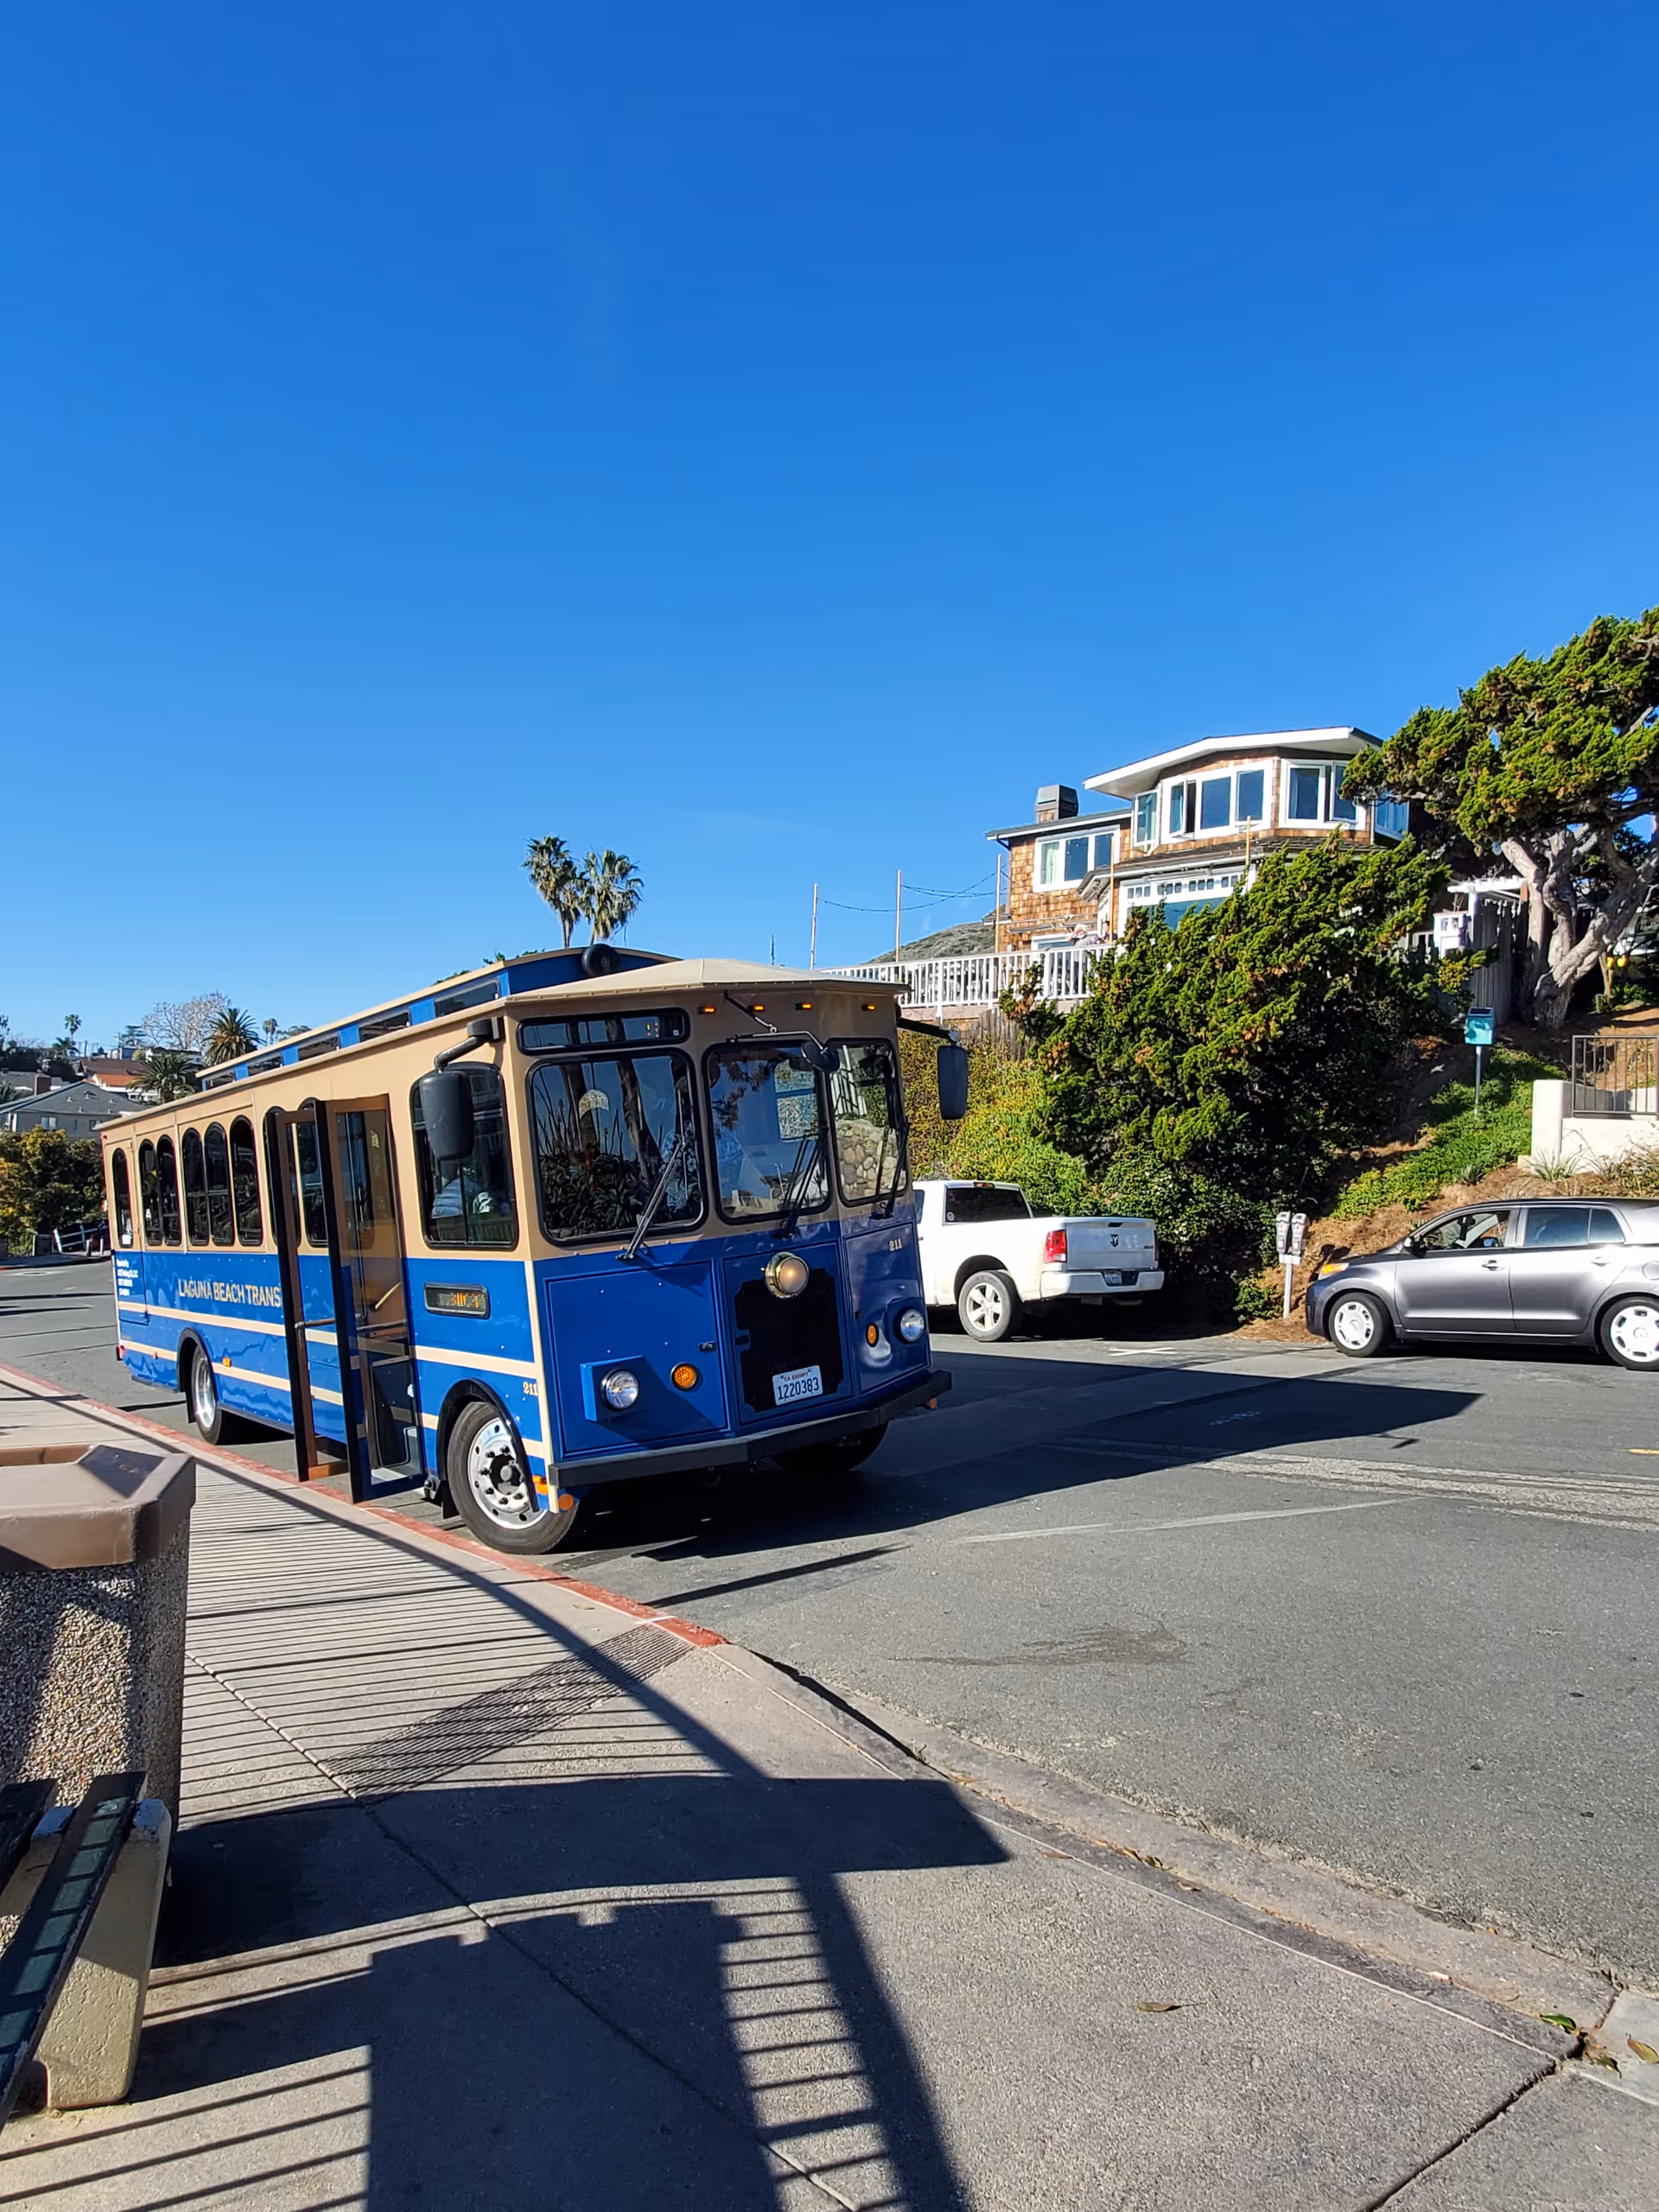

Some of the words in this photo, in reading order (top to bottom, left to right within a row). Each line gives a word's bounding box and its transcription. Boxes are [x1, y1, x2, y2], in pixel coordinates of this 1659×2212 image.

[889, 1238, 902, 1251] 211
[178, 1278, 213, 1300] LAGUNA
[213, 1282, 245, 1304] BEACH
[245, 1284, 282, 1308] TRANS
[523, 1382, 538, 1396] 211
[778, 1376, 820, 1401] 1220383
